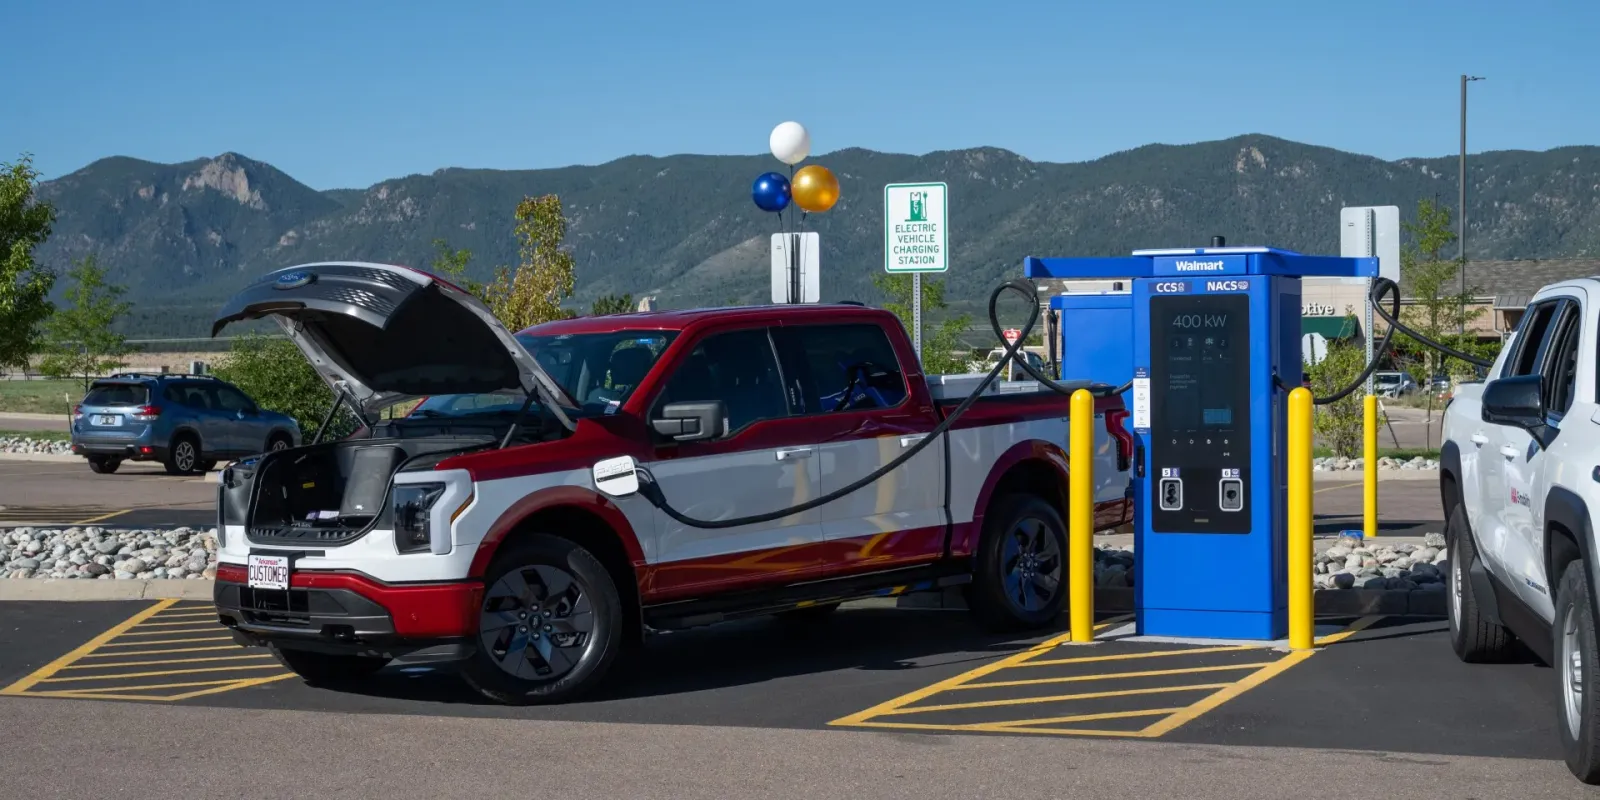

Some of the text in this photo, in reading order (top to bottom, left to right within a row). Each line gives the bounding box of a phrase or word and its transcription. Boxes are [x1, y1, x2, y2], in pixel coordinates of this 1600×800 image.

[895, 224, 937, 233] ELECTRIC
[898, 234, 935, 243] VEHICLE
[893, 245, 940, 254] CHARGING
[898, 256, 935, 264] STATION
[1176, 260, 1224, 271] Walmart
[1156, 283, 1178, 292] CCS
[1207, 281, 1238, 291] NACS
[1172, 314, 1227, 328] 400 kW
[250, 565, 287, 582] CUSTOMER
